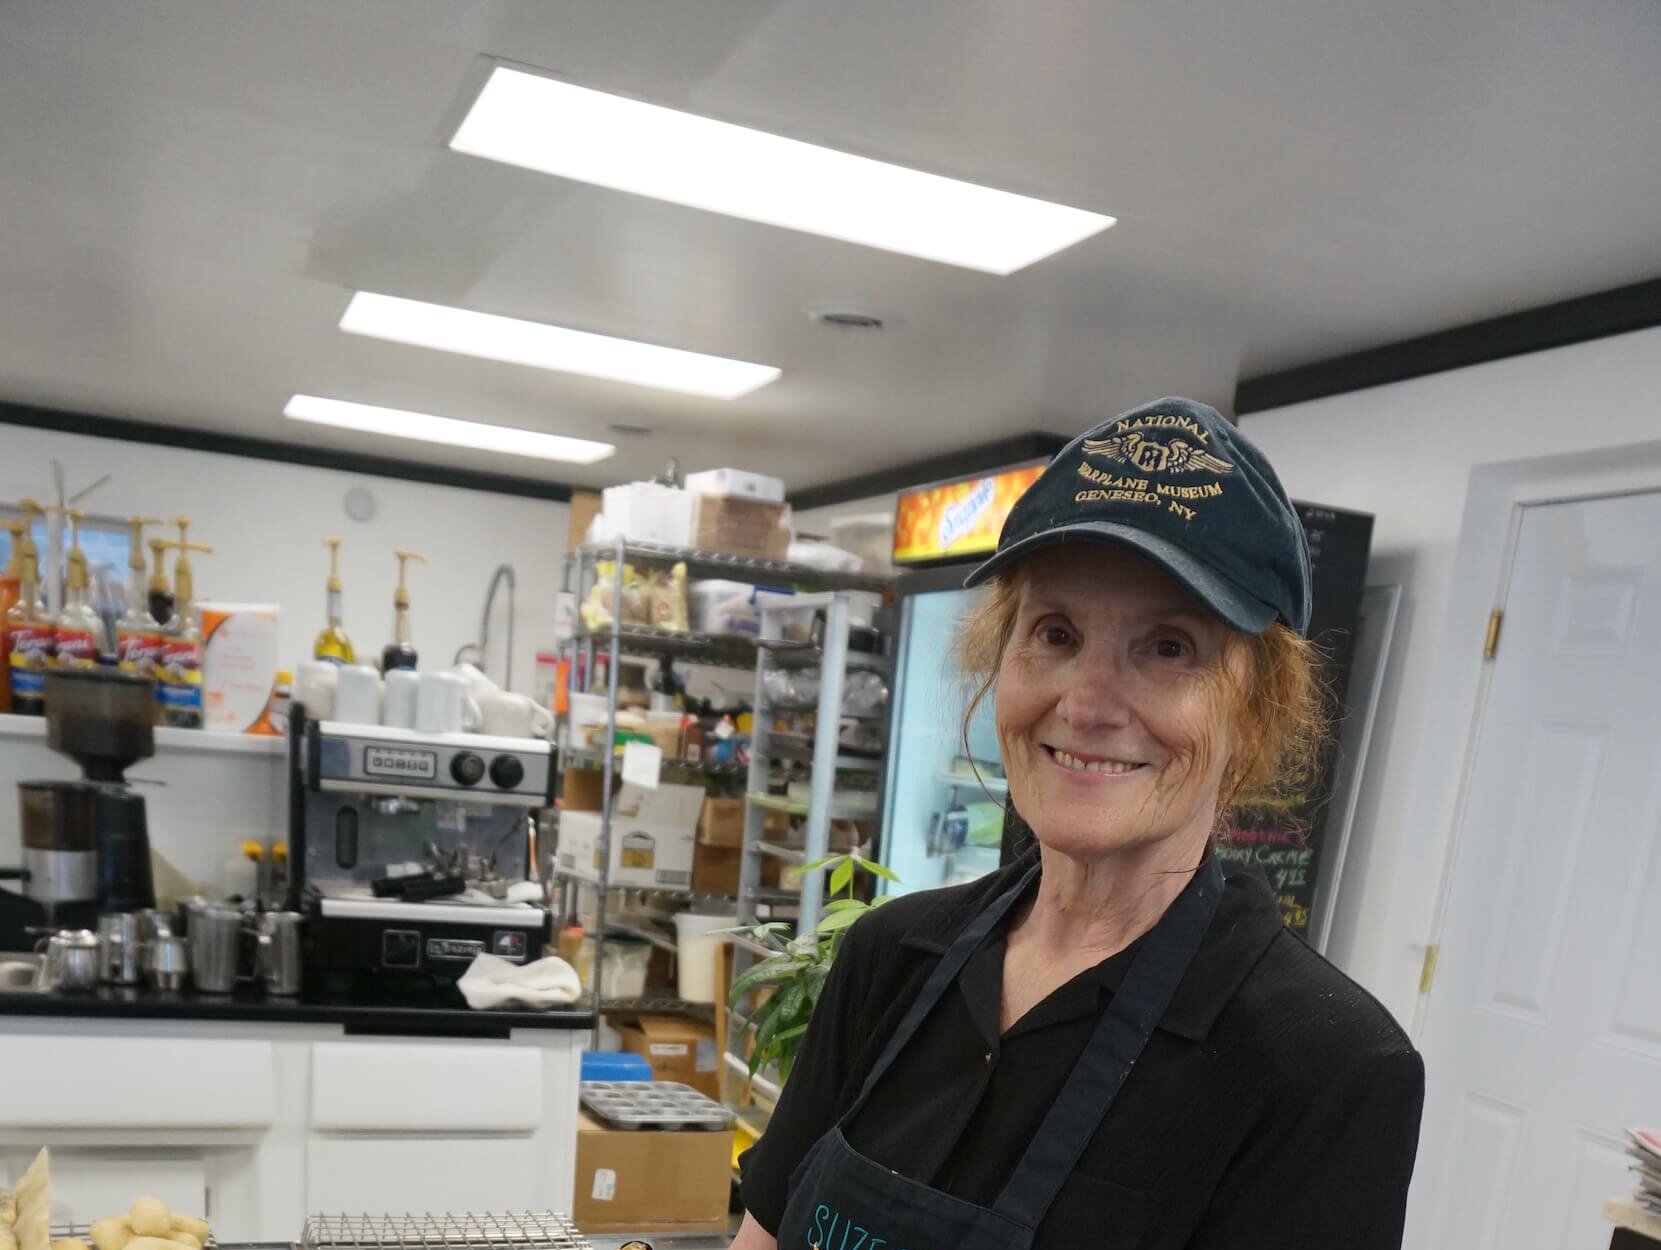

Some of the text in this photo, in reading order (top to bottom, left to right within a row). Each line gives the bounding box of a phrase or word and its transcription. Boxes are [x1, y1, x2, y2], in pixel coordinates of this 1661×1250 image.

[1117, 415, 1209, 444] NATIONAL
[1077, 461, 1223, 499] WARPLANE MUSEUM
[1168, 501, 1197, 520] NY
